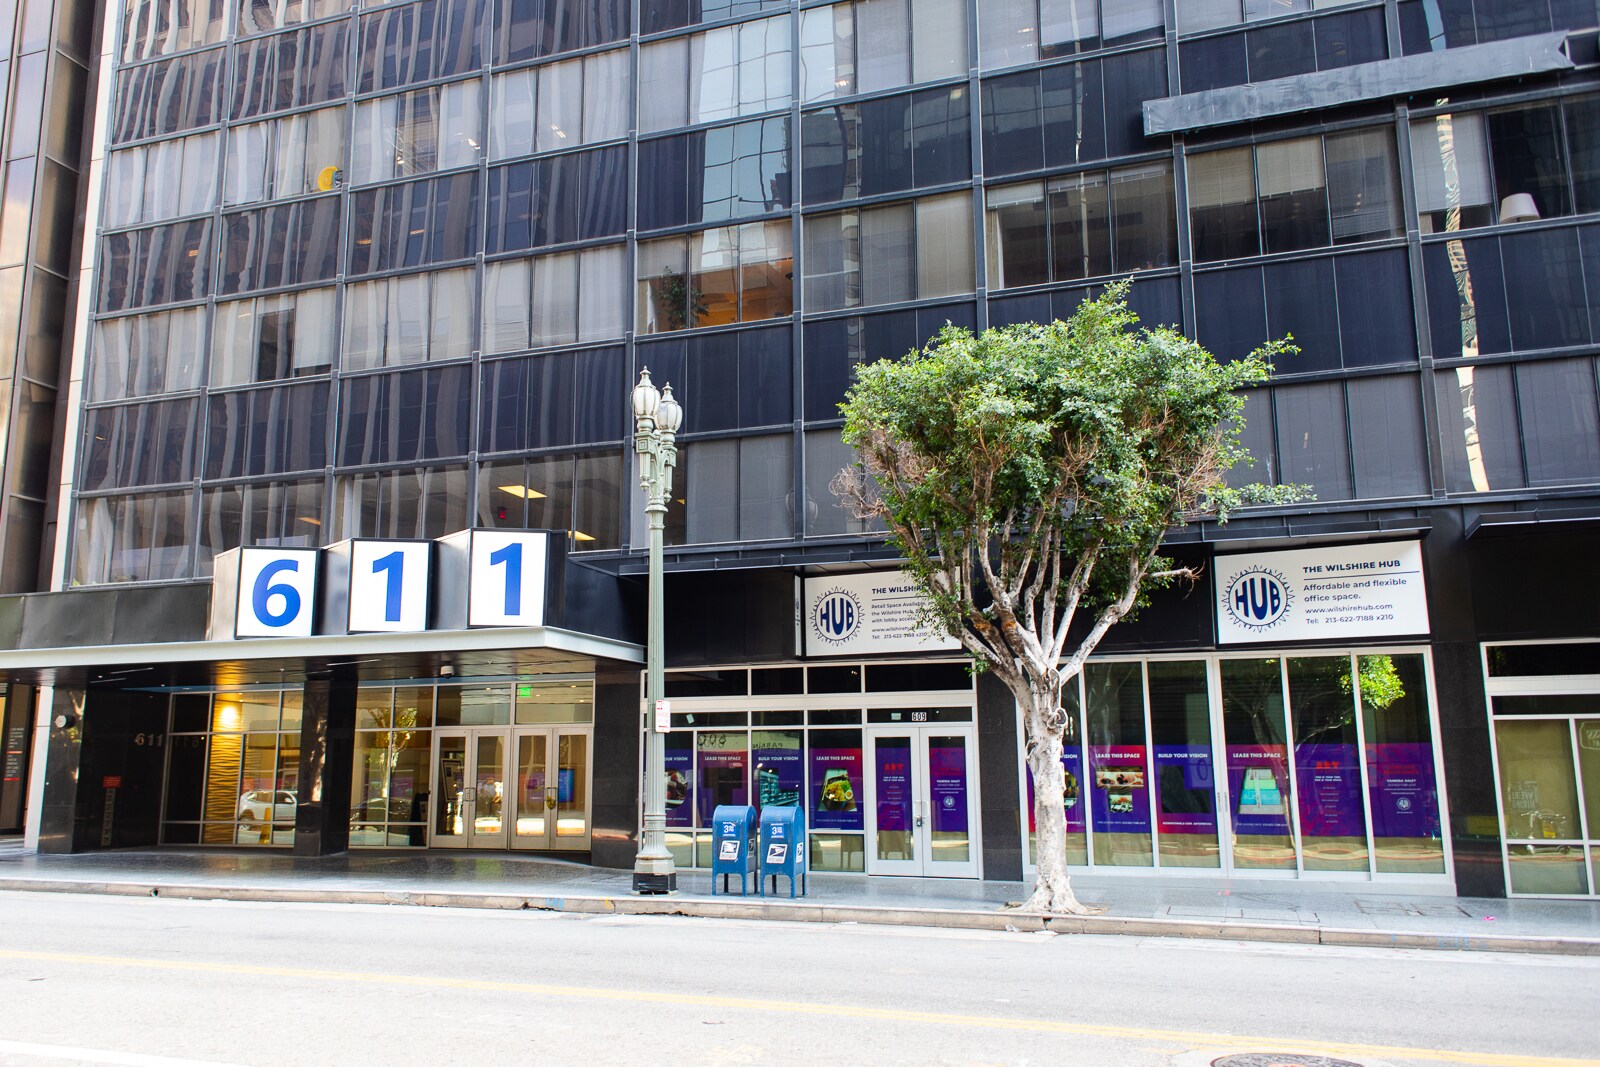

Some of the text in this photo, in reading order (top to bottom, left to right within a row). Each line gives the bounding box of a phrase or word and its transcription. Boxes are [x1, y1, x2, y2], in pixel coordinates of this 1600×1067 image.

[1302, 560, 1401, 574] THE WILSHIRE HUB
[1304, 578, 1407, 591] Affordable and flexible
[1235, 577, 1281, 620] HUB
[1304, 594, 1361, 602] office space.
[1305, 603, 1392, 614] www.wilshirehub.com
[820, 598, 854, 635] HUB
[1325, 614, 1374, 624] 213-622-7188
[913, 712, 926, 721] 609
[135, 733, 163, 746] 611
